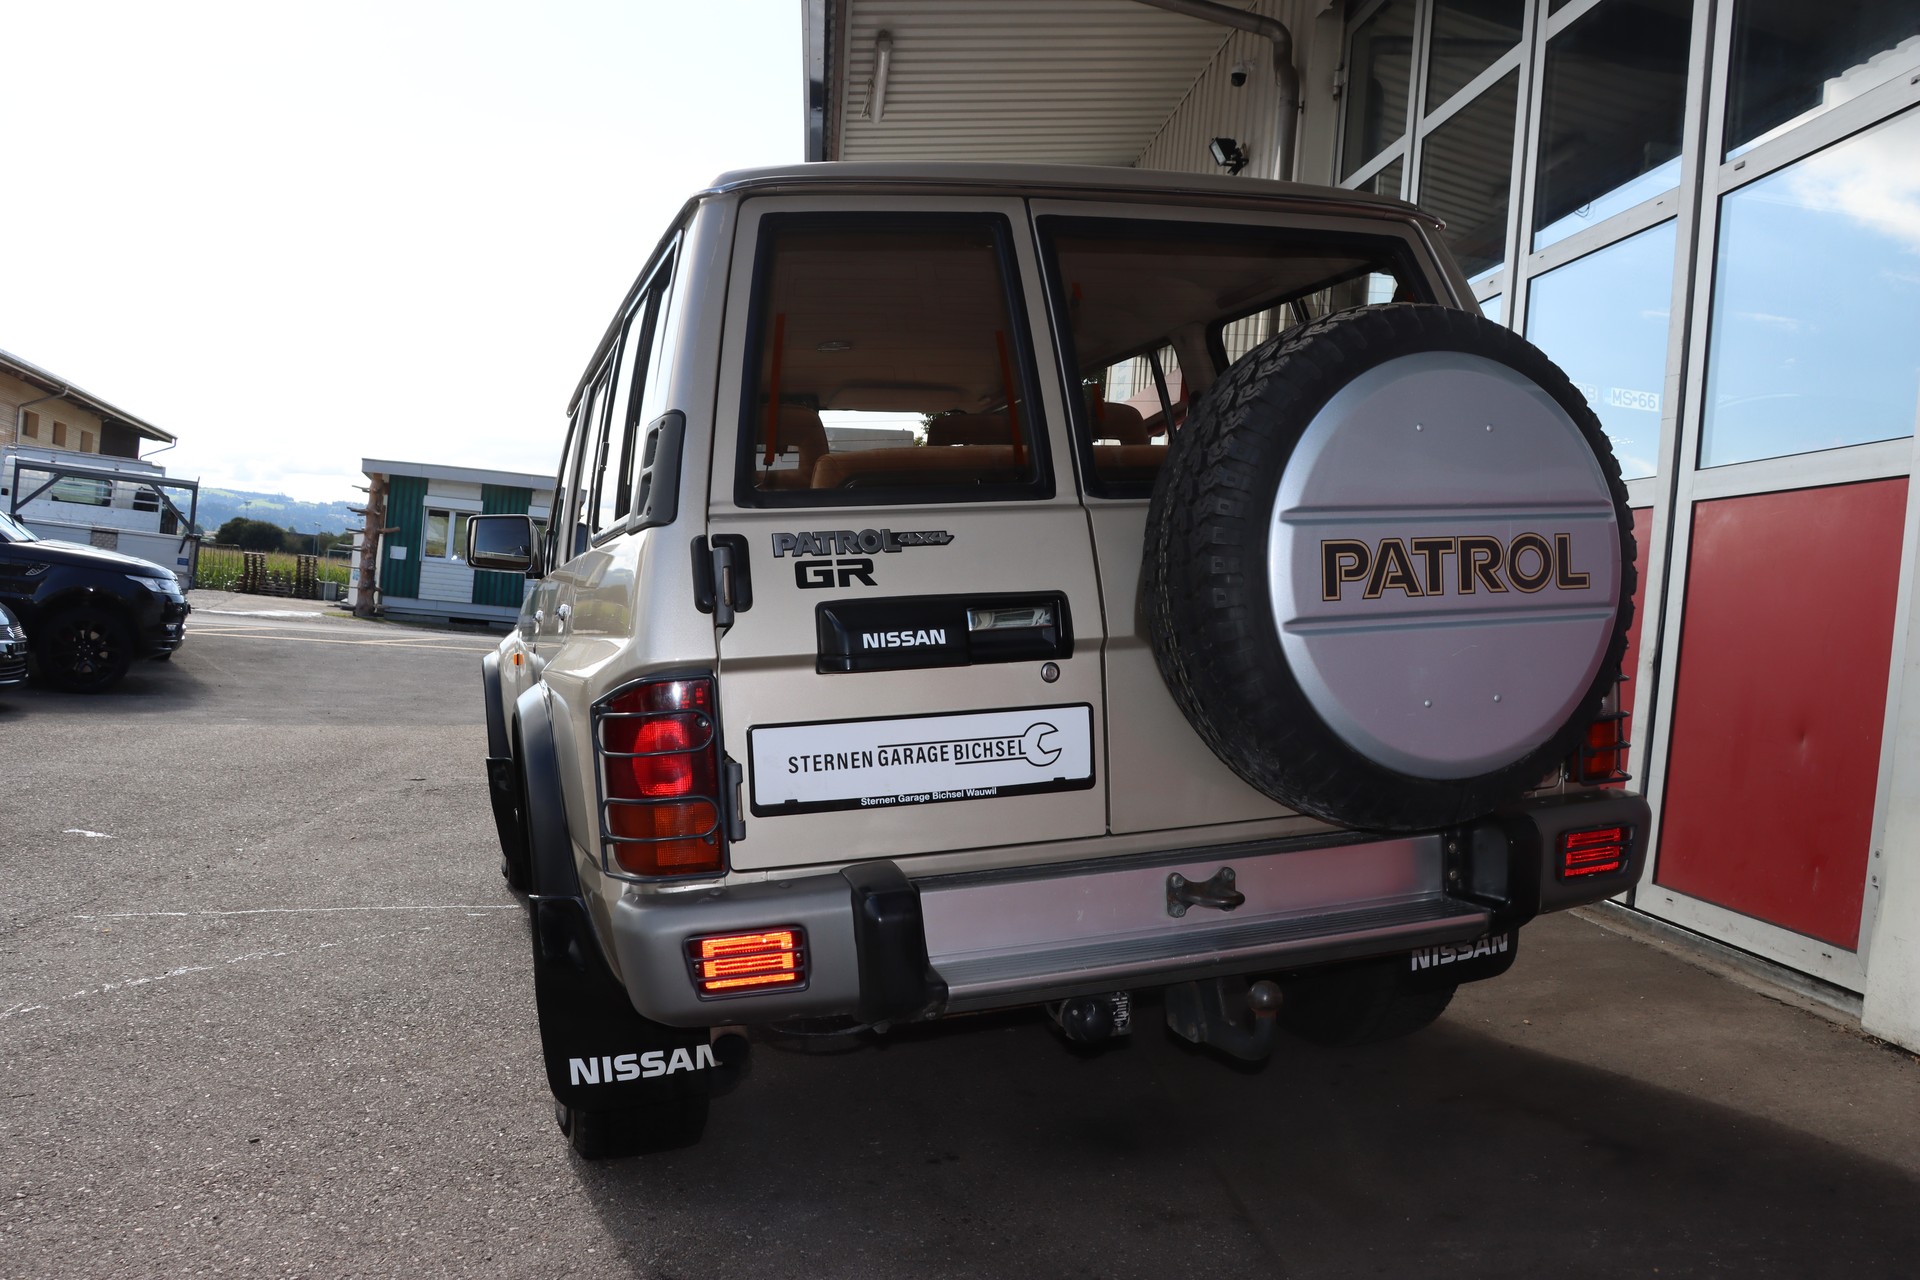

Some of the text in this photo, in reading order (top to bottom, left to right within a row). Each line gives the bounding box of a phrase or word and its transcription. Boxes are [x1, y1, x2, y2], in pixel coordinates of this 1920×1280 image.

[771, 528, 903, 559] PATROL
[794, 557, 879, 590] GR
[1320, 531, 1591, 602] PATROL
[862, 628, 947, 649] NISSAN
[788, 739, 1027, 774] STERNEN GARAGE BICHSEL
[860, 786, 998, 806] Sternen Garage Bichsel Wauwil
[1411, 932, 1509, 972] NISSAN
